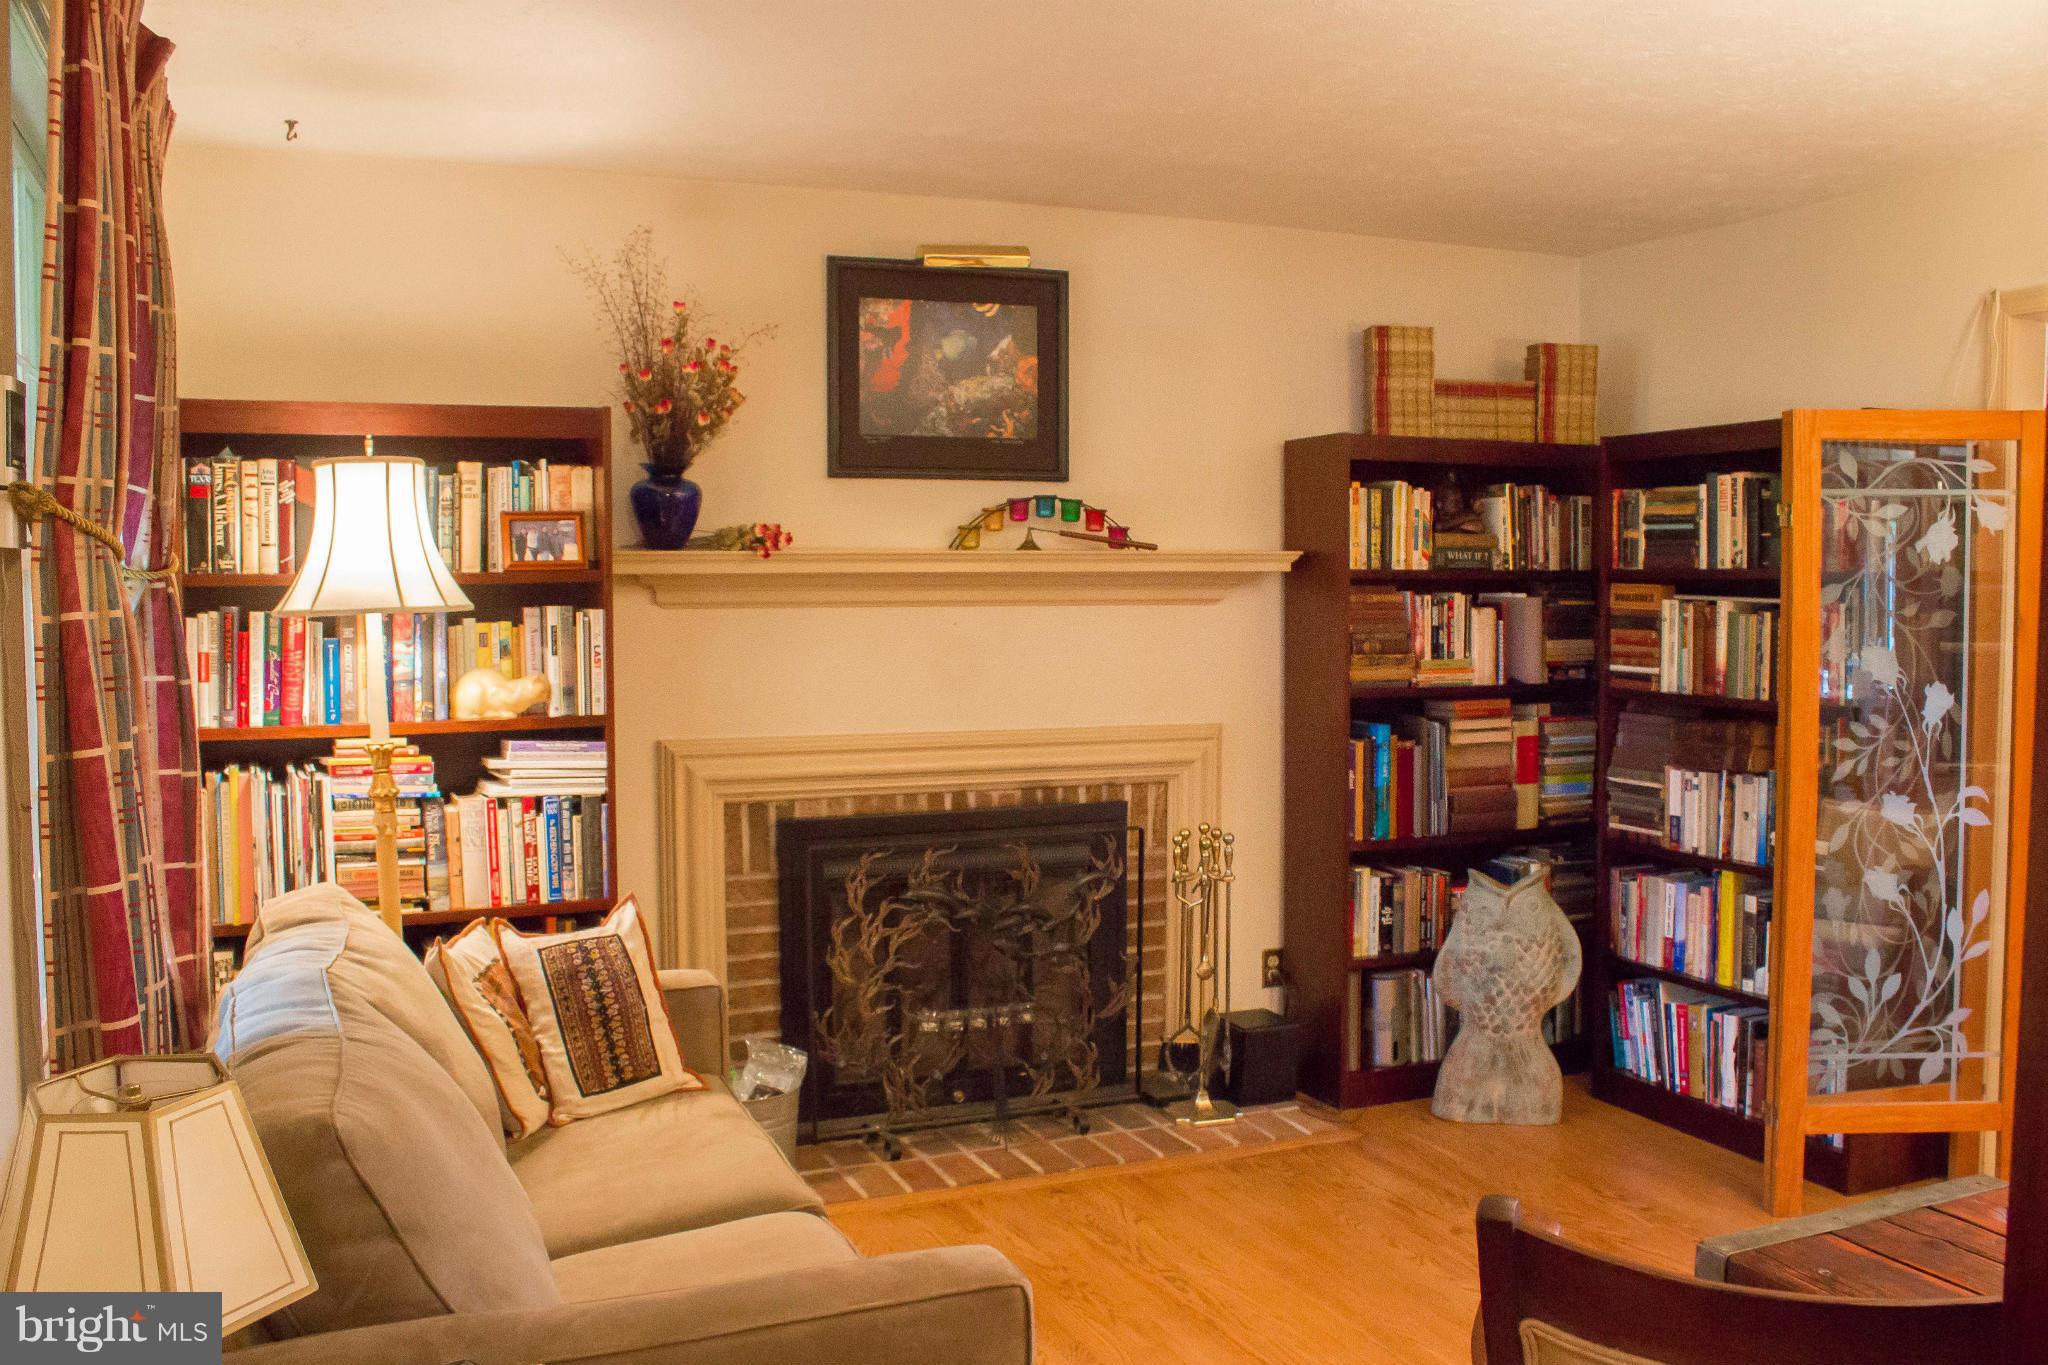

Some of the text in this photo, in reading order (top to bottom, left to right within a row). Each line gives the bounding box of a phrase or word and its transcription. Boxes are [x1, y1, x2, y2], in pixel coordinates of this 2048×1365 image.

[212, 463, 225, 492] James
[215, 503, 227, 546] Michener
[1448, 551, 1471, 560] WHAT
[344, 644, 354, 672] GORKY
[593, 645, 602, 670] LAST
